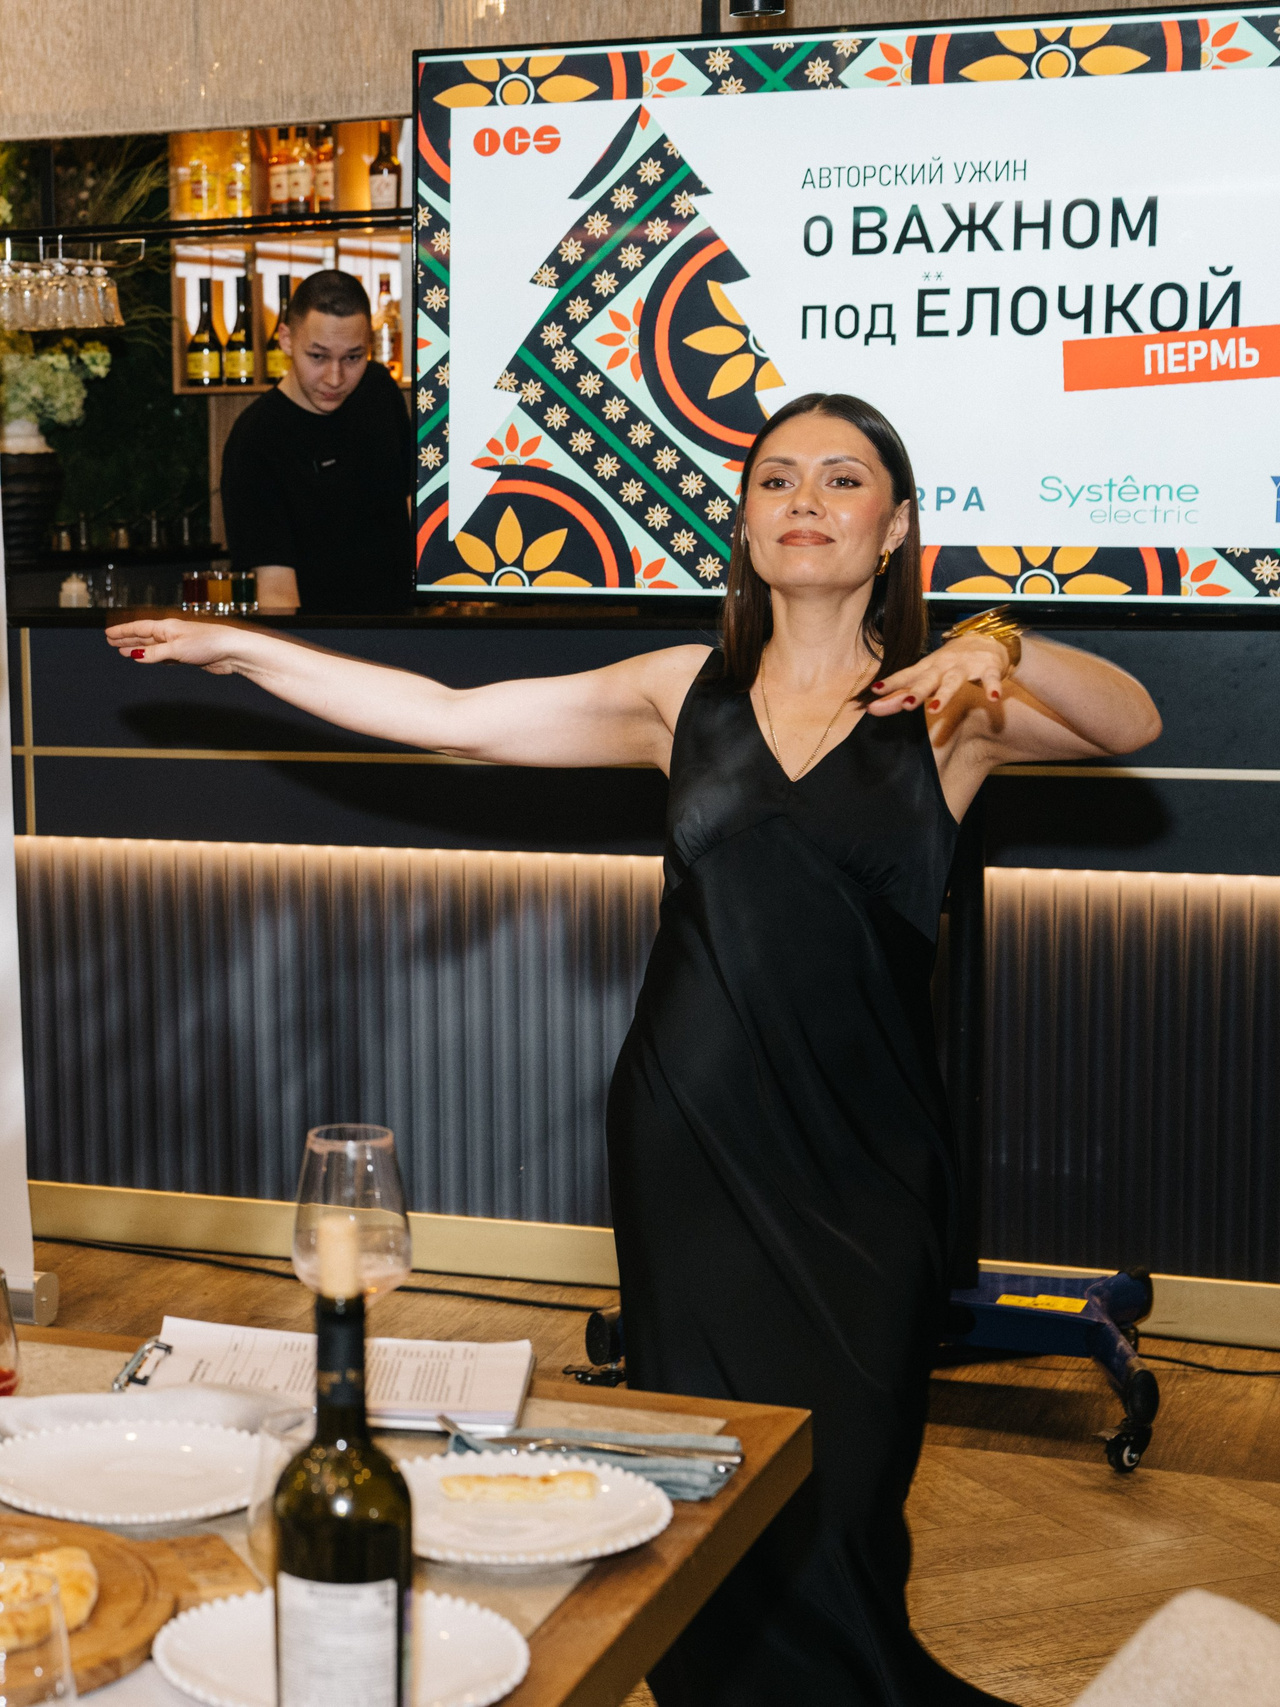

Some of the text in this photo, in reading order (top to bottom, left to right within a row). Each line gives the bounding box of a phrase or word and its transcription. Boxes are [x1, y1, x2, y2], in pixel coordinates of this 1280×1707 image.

[473, 125, 561, 157] OCS
[801, 156, 1028, 190] АВТОРСКИЙ УЖИН
[851, 196, 1158, 256] ВАЖНОМ
[801, 265, 1242, 346] под ЁЛОЧКОЙ
[1143, 336, 1260, 376] ПЕРМЬ
[1039, 475, 1200, 508] Système
[1089, 504, 1200, 524] electric
